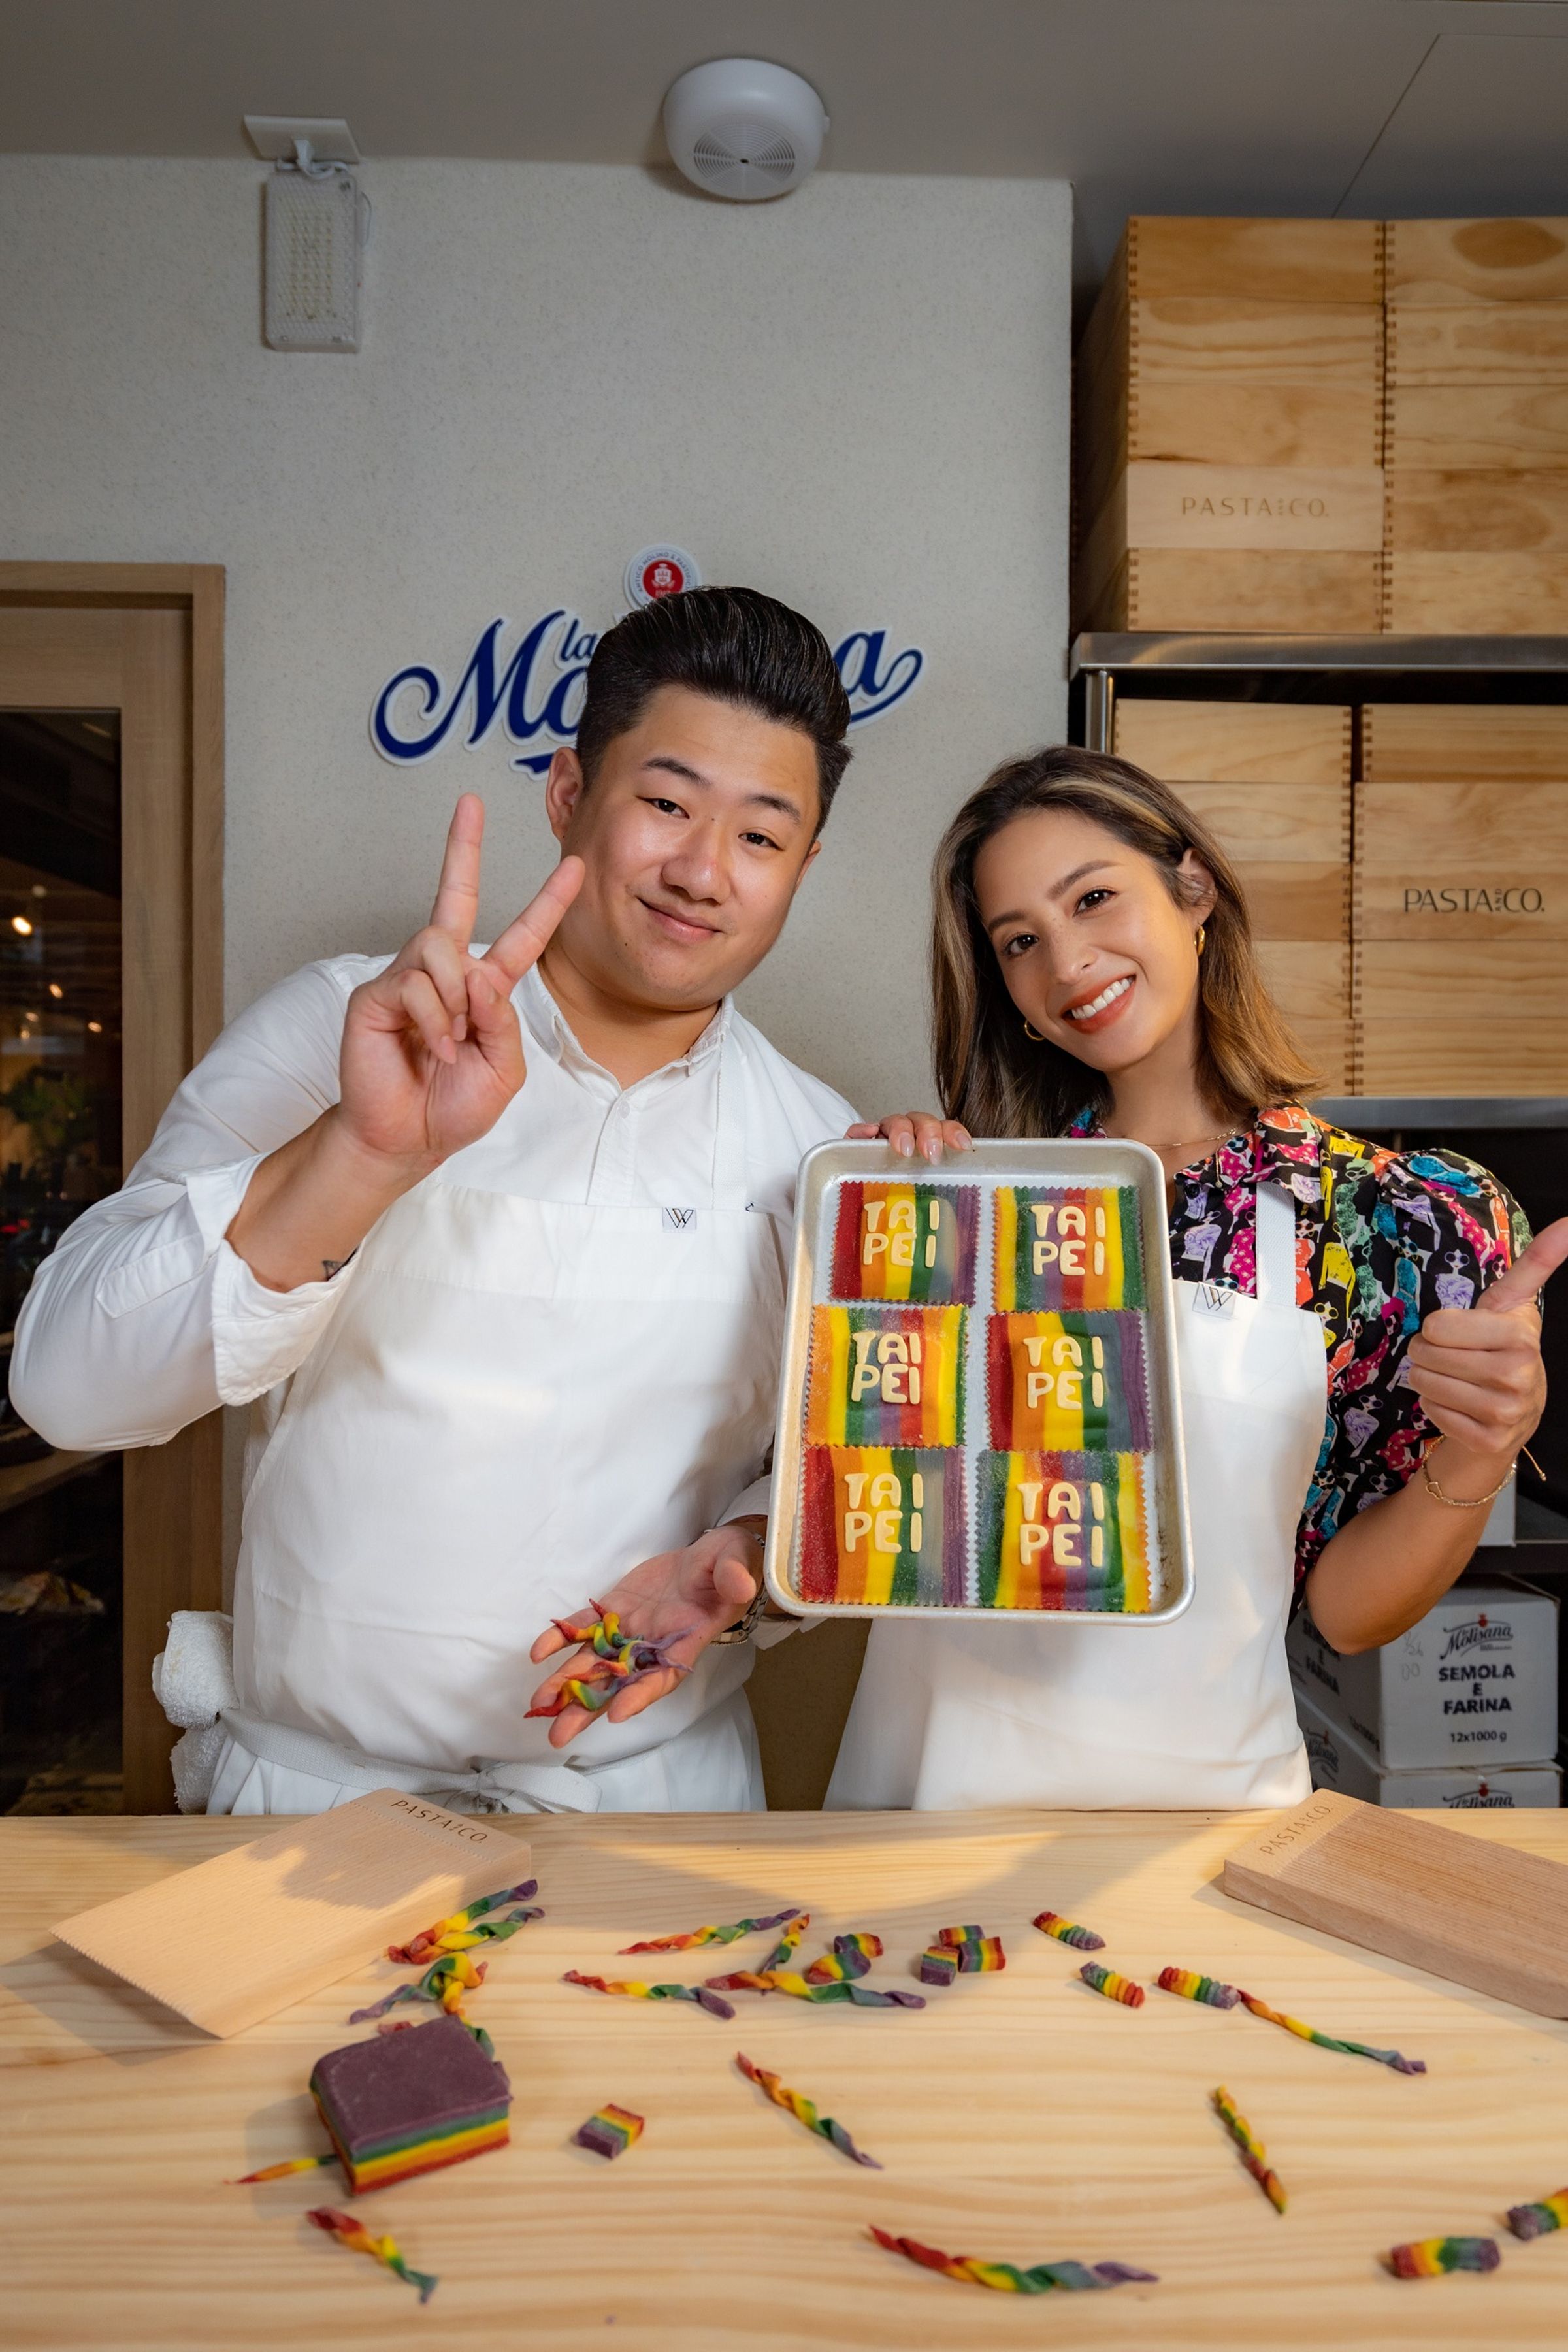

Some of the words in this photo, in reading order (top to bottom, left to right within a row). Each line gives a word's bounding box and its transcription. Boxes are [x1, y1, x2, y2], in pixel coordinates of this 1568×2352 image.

[1181, 497, 1273, 516] PASTA
[560, 618, 597, 661] la
[1404, 888, 1494, 913] PASTA
[1503, 887, 1545, 913] CO.
[864, 1200, 939, 1233] TAI
[1030, 1205, 1105, 1238] TAI
[863, 1232, 936, 1267] PEI
[1032, 1239, 1105, 1276] PEI
[852, 1331, 921, 1364] TAI
[1024, 1335, 1104, 1370] TAI
[851, 1363, 920, 1404] PEI
[1028, 1371, 1103, 1410] PEI
[844, 1473, 924, 1509] TAI
[1017, 1482, 1105, 1521] TAI
[844, 1509, 922, 1553] PEI
[1019, 1523, 1103, 1567] PEI
[1439, 1664, 1516, 1682] SEMOLA
[1473, 1682, 1483, 1697] E
[1443, 1697, 1512, 1716] FARINA
[1450, 1731, 1498, 1743] 12x1000
[1500, 1731, 1507, 1742] g
[390, 1799, 453, 1829] PASTA
[1259, 1821, 1311, 1855] PASTA
